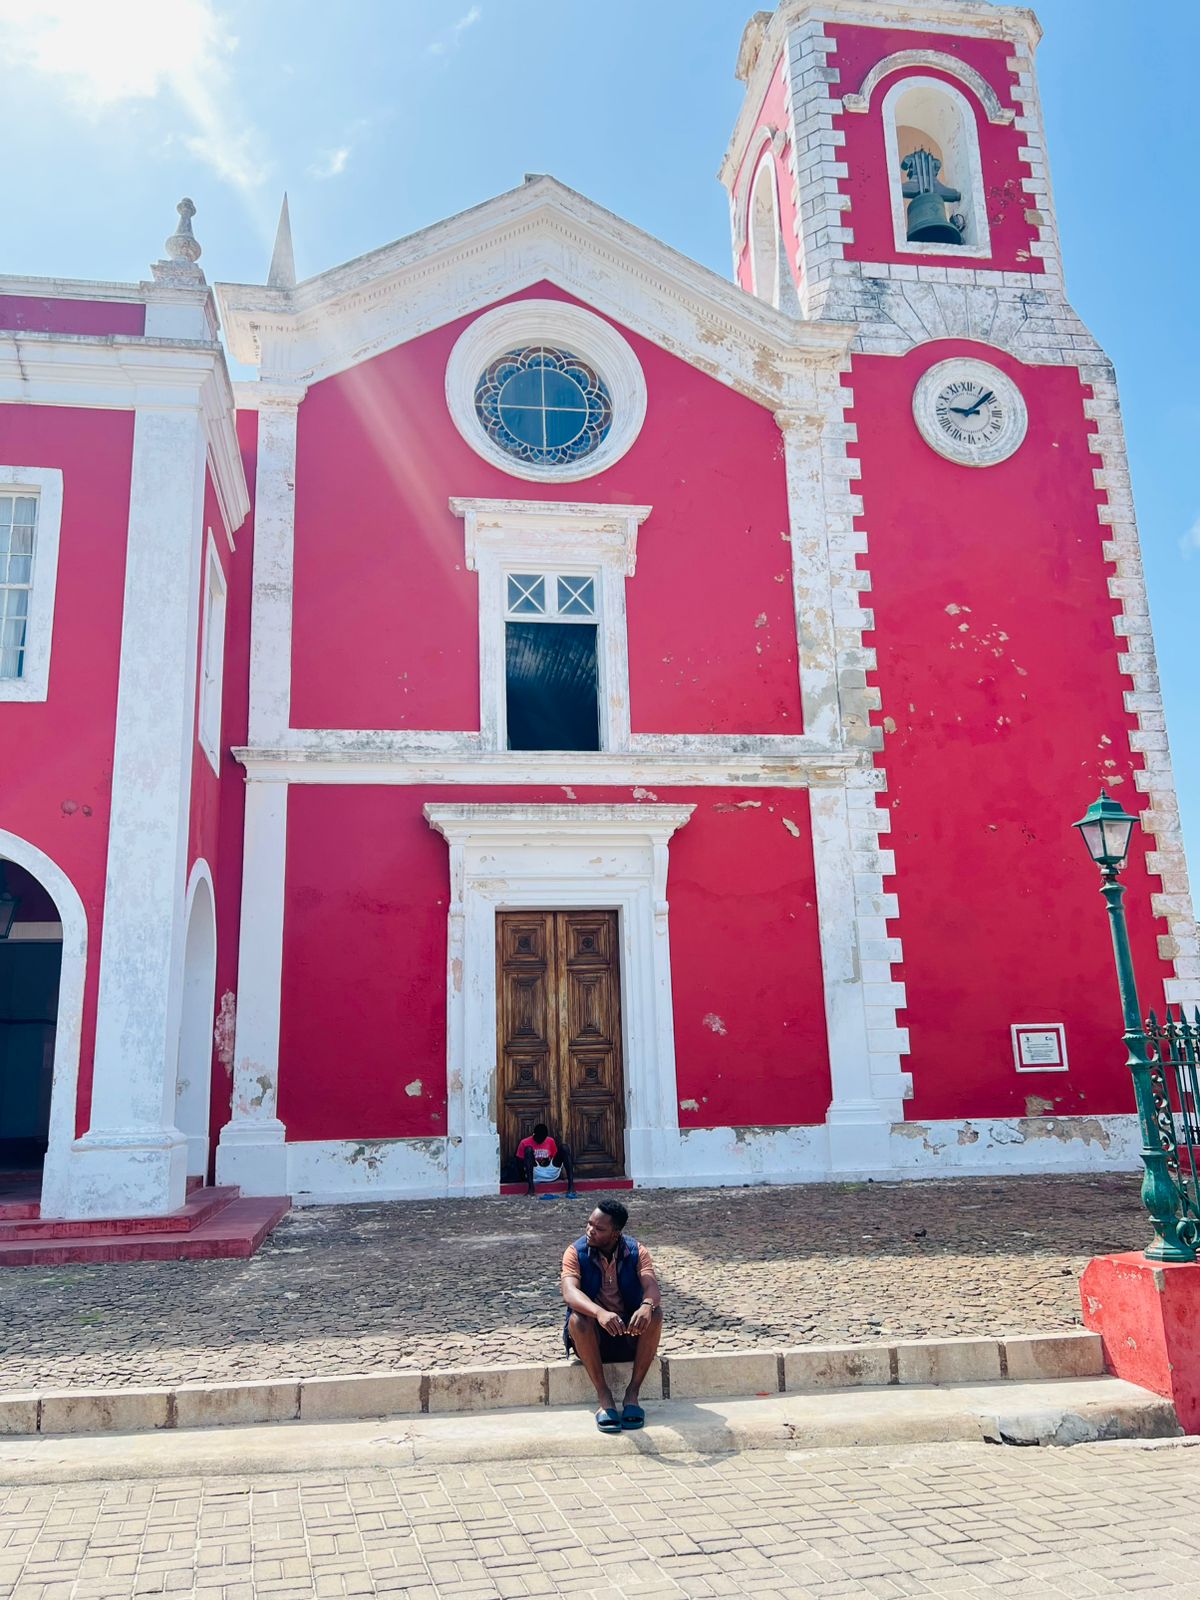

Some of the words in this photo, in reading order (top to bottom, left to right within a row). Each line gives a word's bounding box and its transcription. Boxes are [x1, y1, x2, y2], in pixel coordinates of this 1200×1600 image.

[948, 384, 959, 395] XI
[960, 382, 972, 391] XII
[938, 394, 949, 403] X
[988, 396, 997, 404] II
[936, 406, 947, 415] IX
[939, 418, 951, 432] VIII
[991, 422, 1000, 433] IV
[951, 429, 961, 441] VII
[968, 434, 976, 444] VI
